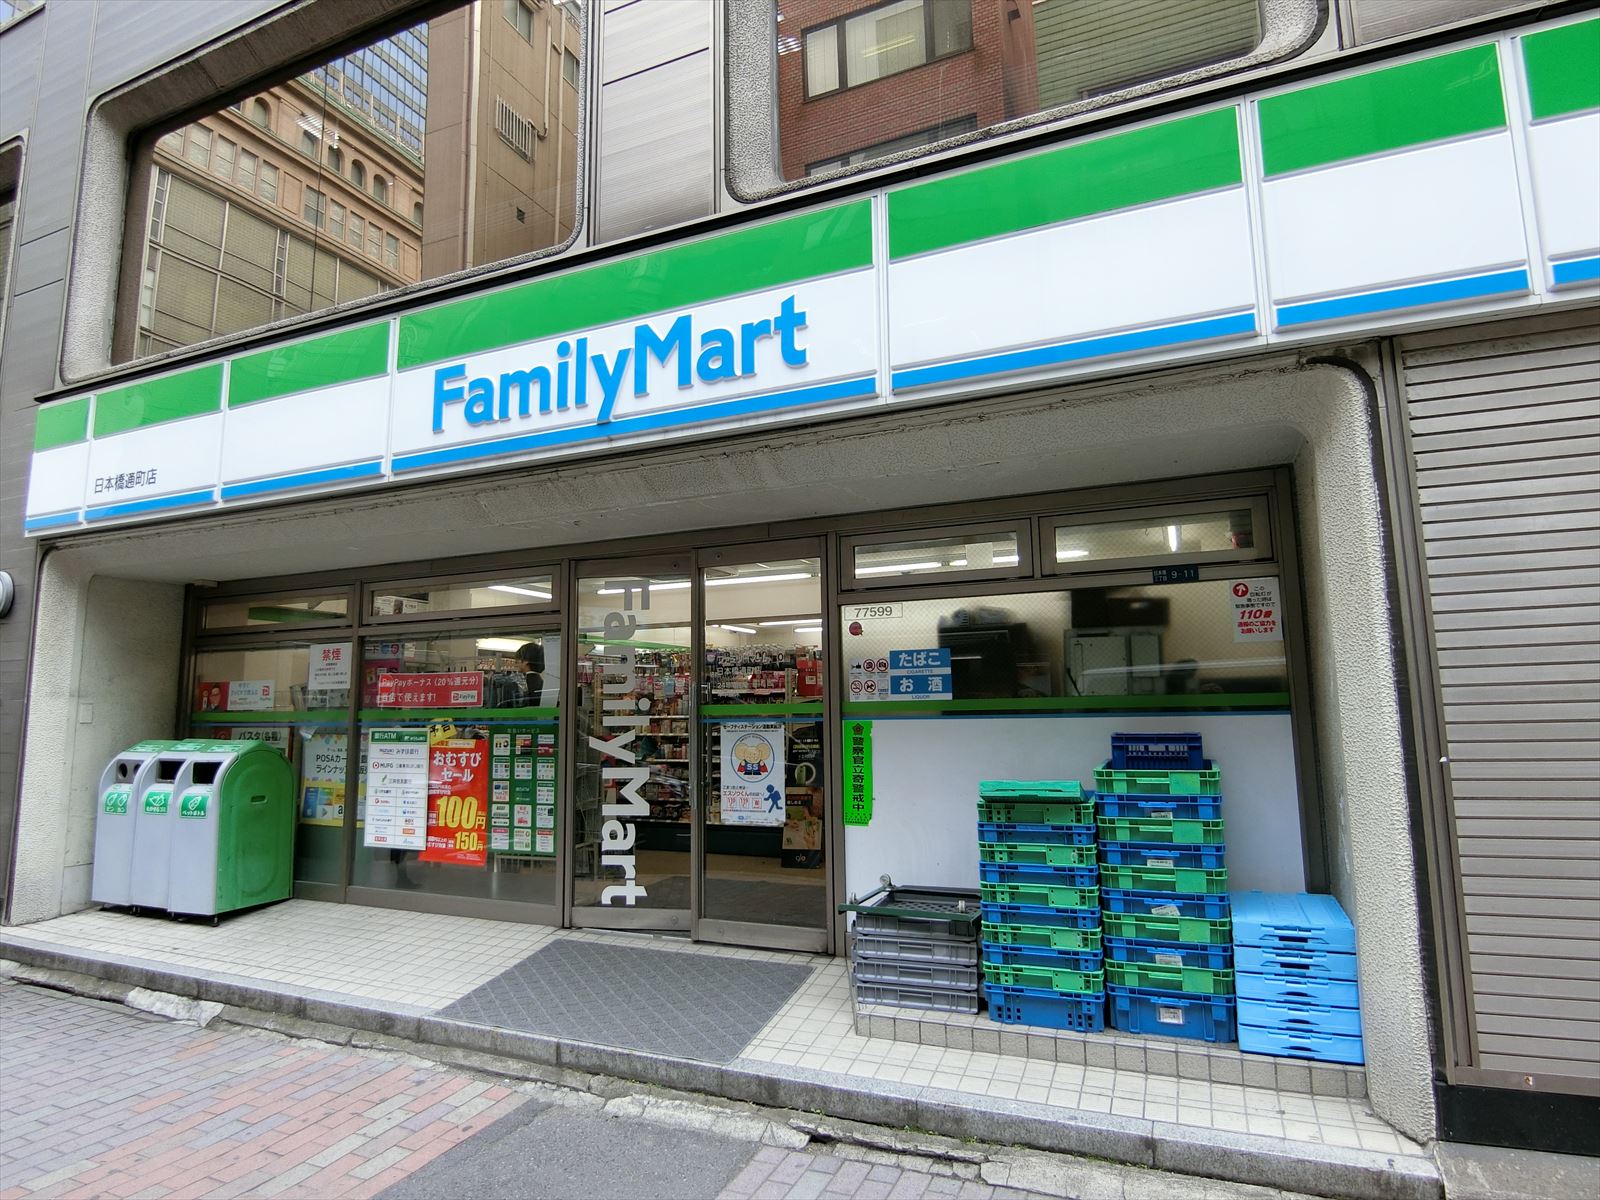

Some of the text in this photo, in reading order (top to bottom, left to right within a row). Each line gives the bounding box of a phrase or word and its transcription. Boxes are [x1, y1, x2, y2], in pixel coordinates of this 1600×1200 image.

[432, 294, 808, 434] FamilyMart
[94, 468, 158, 493] 日本橋通町店
[854, 605, 893, 618] 77599
[322, 648, 342, 662] 禁煙
[899, 652, 941, 667] たばこ
[588, 580, 650, 906] FamilyMart
[433, 751, 482, 767] おむすび
[441, 768, 474, 783] セール
